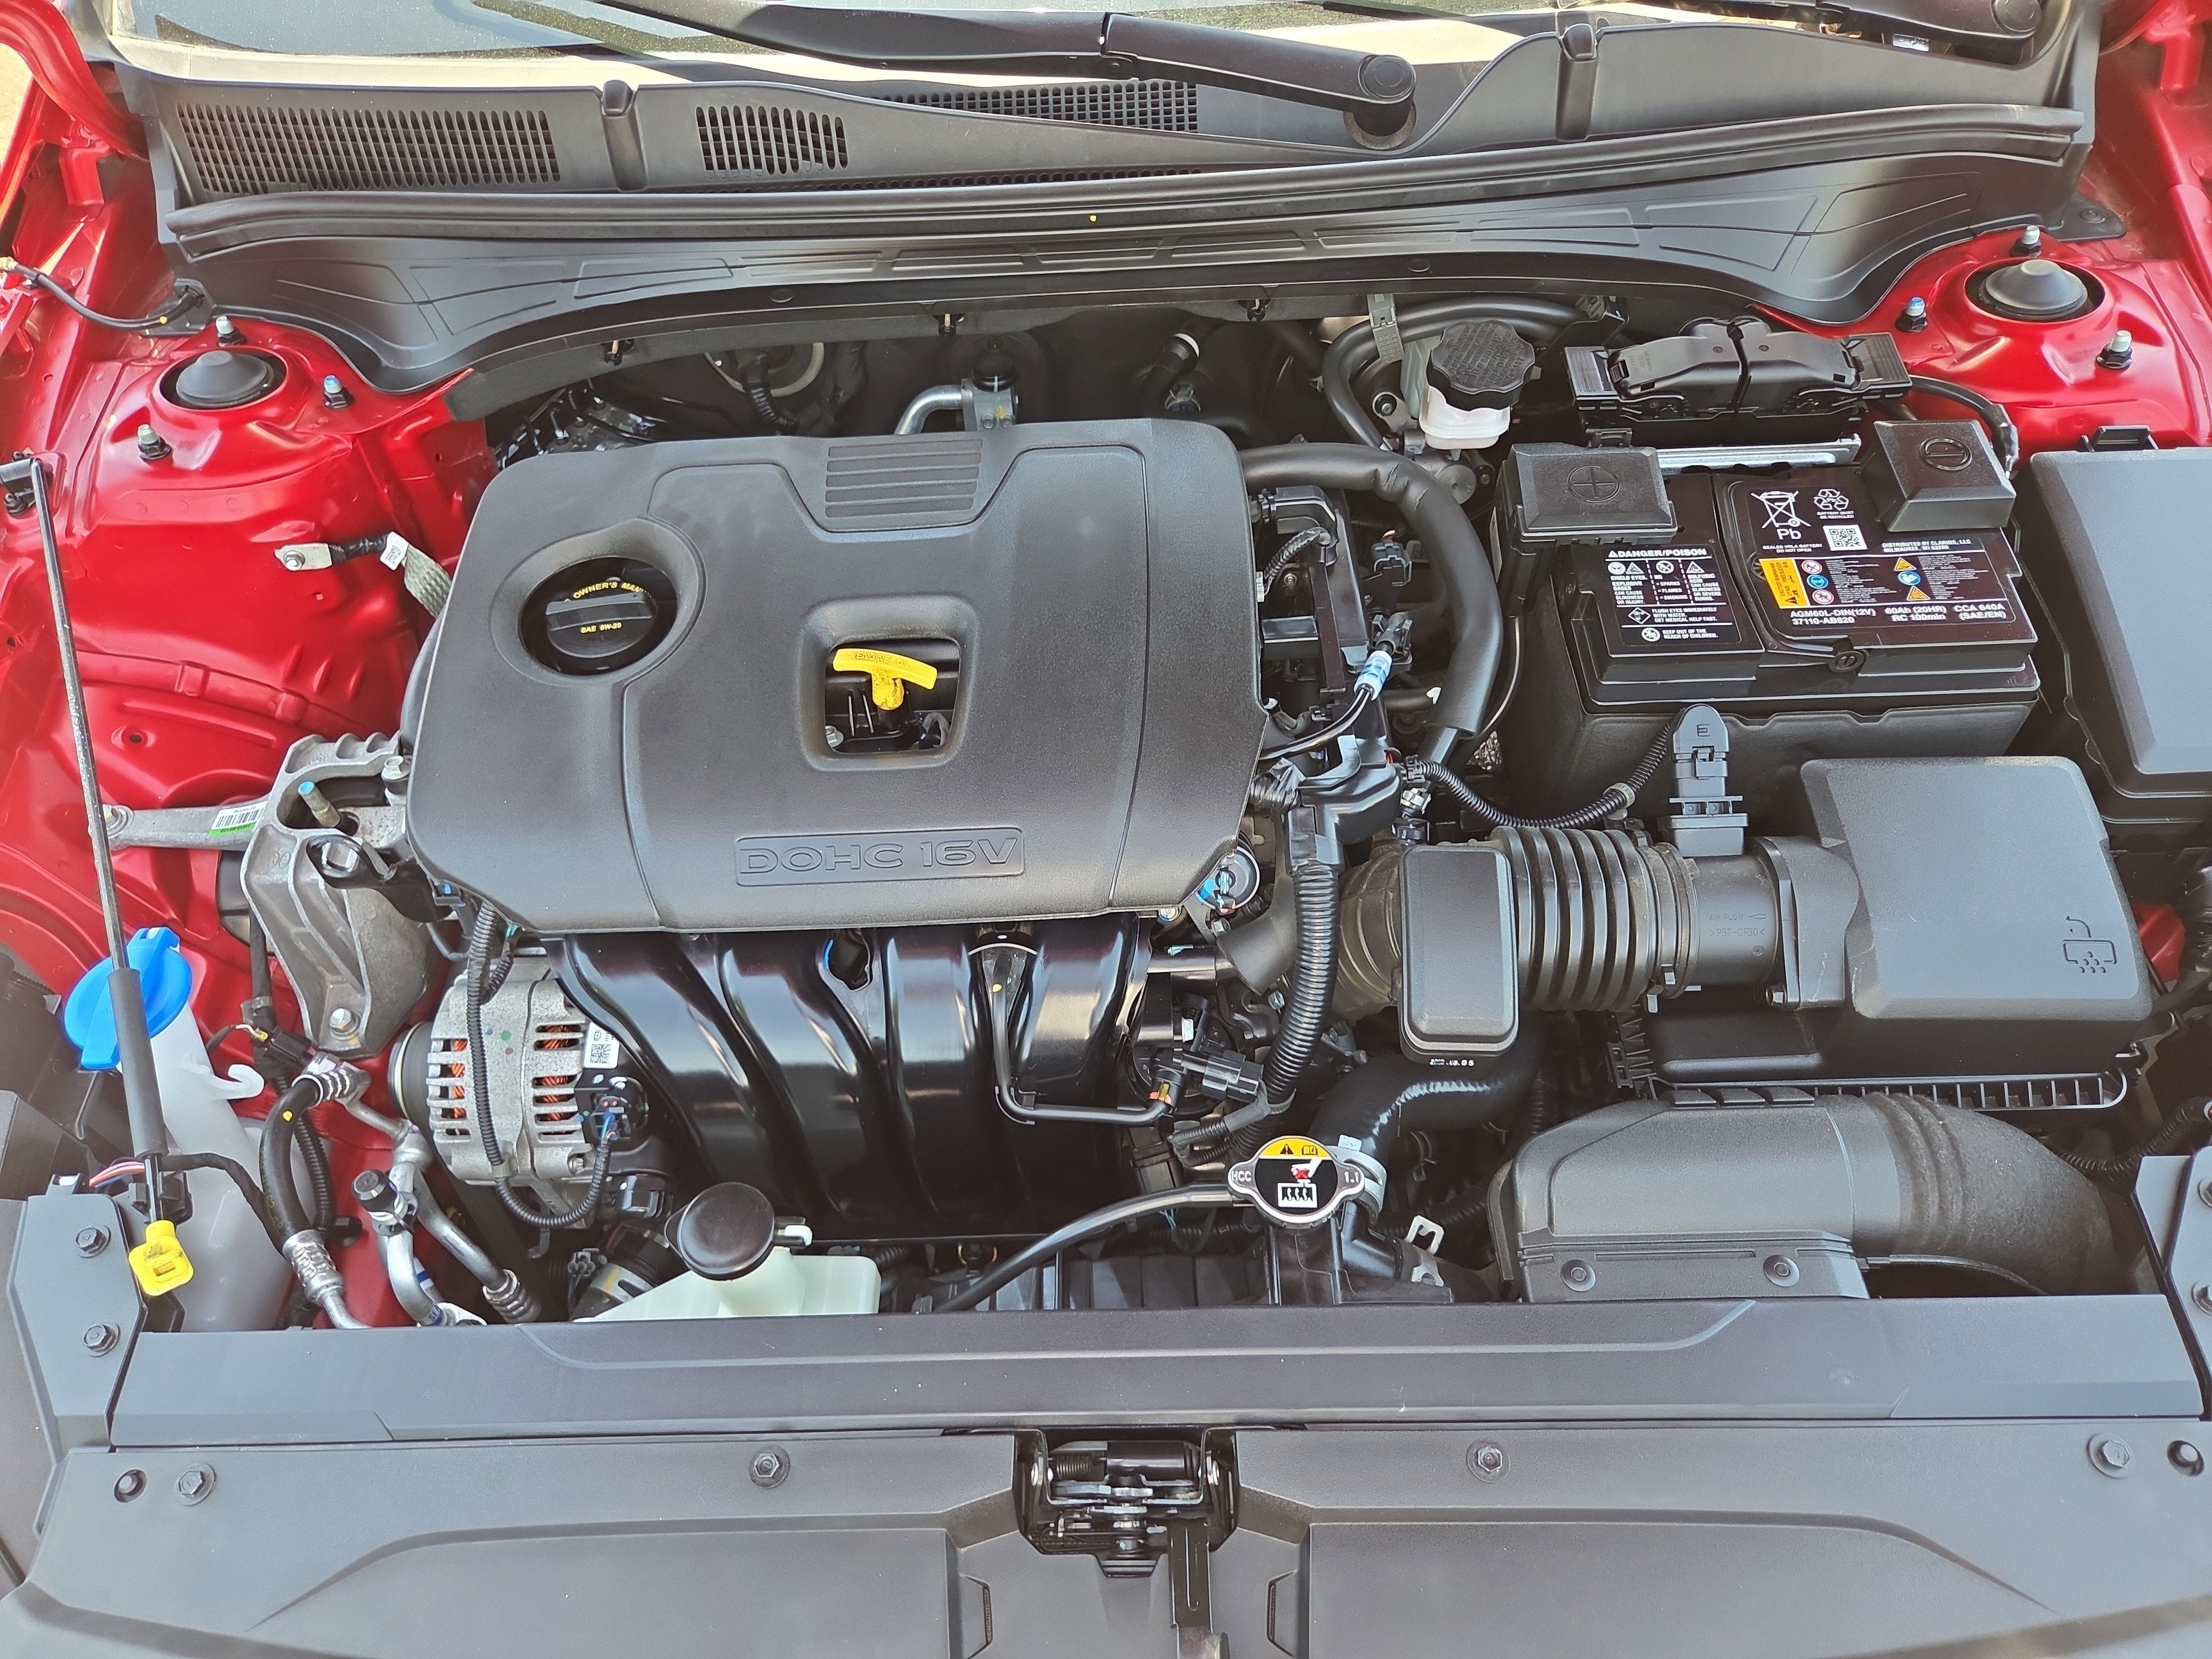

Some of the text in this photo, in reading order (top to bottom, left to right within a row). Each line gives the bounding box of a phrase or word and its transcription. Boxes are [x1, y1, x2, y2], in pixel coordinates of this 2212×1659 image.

[1777, 528, 1802, 540] Pb
[1618, 549, 1707, 557] DANGER/POISON
[573, 582, 618, 599] OWNER'S
[1791, 608, 1876, 618] AGM60L-DIN(12V)
[1913, 606, 1946, 614] (20HR)
[1792, 617, 1855, 625] 37110-AB620
[1958, 612, 2006, 621] (SAE/EN)
[855, 652, 911, 669] ENGINE OIL
[740, 838, 1018, 873] DOHC 16V
[1232, 1170, 1359, 1183] HCC 1.1
